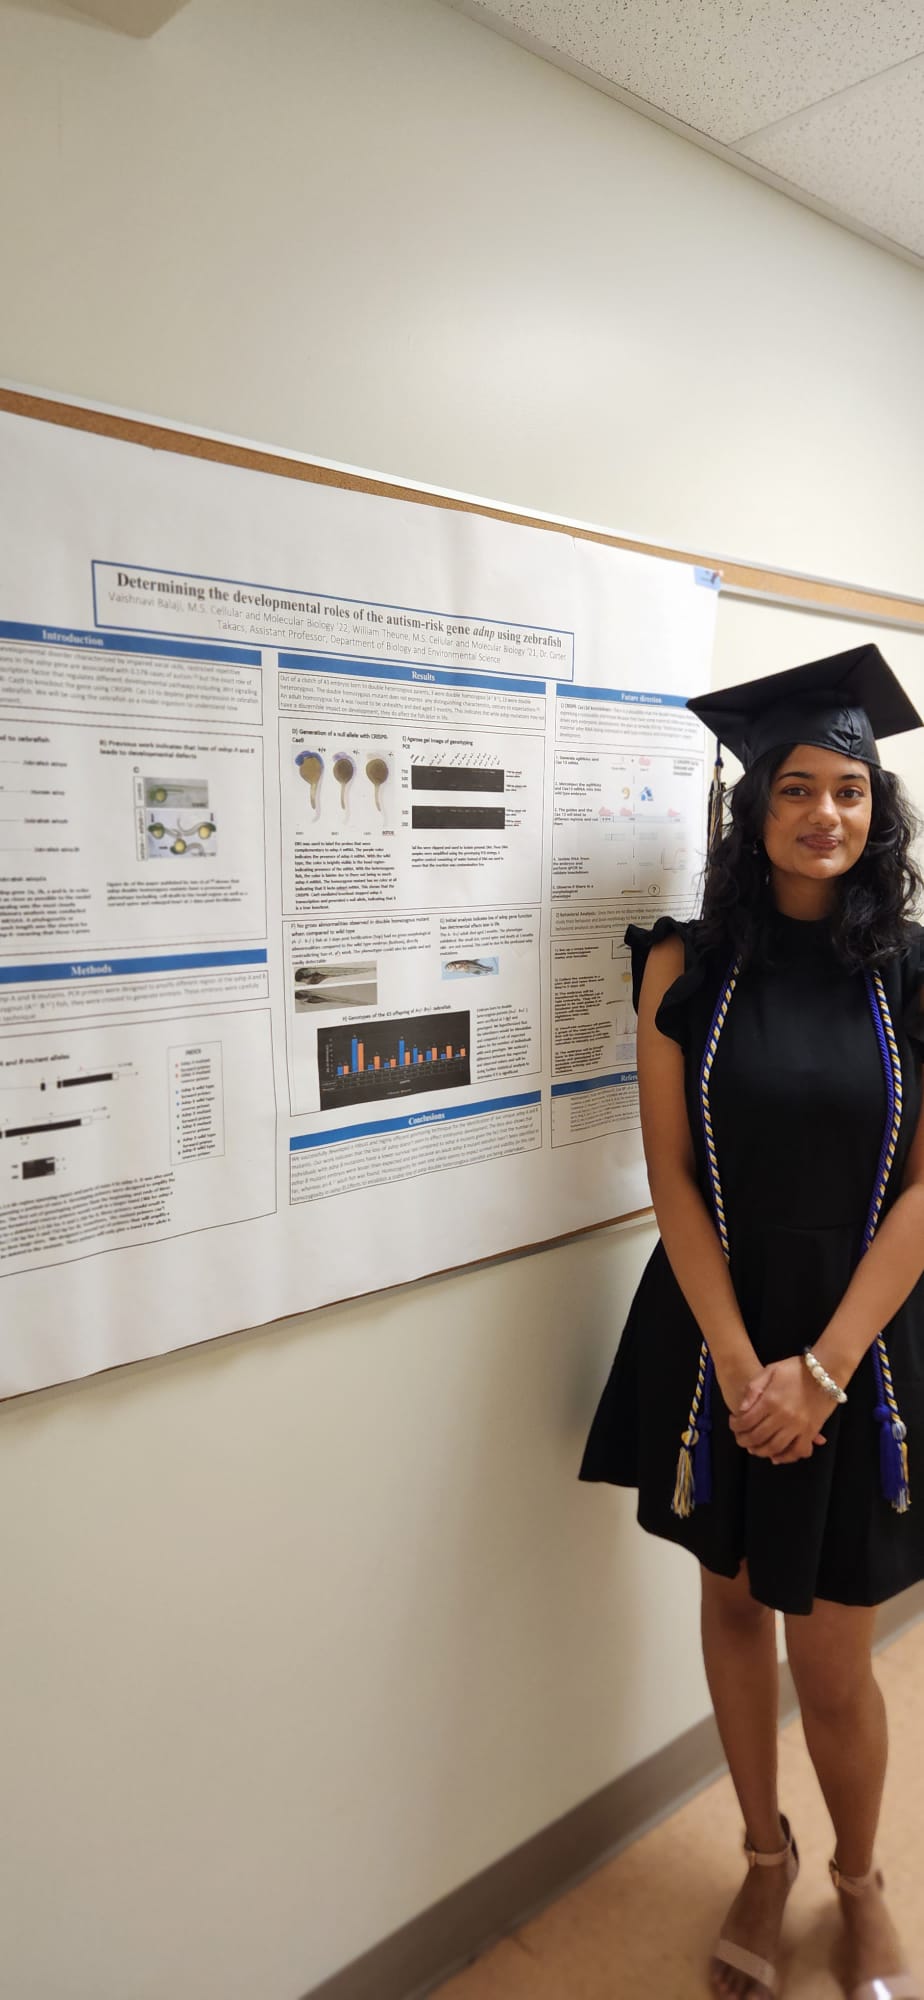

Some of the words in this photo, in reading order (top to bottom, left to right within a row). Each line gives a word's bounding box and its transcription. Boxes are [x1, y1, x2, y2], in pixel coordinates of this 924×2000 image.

[117, 572, 206, 600] Determining
[209, 586, 230, 601] the
[233, 590, 321, 614] developmental
[323, 604, 350, 618] roles
[353, 608, 365, 620] of
[366, 610, 384, 624] the
[386, 614, 444, 632] autism-risk
[446, 624, 471, 636] gene
[473, 624, 495, 641] adnp
[497, 630, 521, 645] using
[523, 630, 562, 648] zebrafish
[108, 591, 154, 607] Vaishnavi
[187, 603, 209, 614] M.S.
[210, 605, 243, 618] Cellular
[245, 610, 261, 621] and
[263, 613, 304, 626] Molecular
[307, 618, 335, 632] Biology
[353, 624, 380, 637] William
[382, 628, 411, 642] Theune,
[413, 632, 427, 642] M.S.
[429, 635, 454, 646] Cellular
[456, 638, 470, 648] and
[472, 640, 502, 652] Molecular
[504, 643, 526, 656] Biology
[539, 649, 548, 658] Dr.
[549, 650, 567, 661] Carter
[42, 629, 104, 647] Introduction
[217, 620, 247, 633] Takacs,
[250, 625, 286, 638] Assistant
[288, 629, 328, 644] Professor,
[330, 634, 375, 650] Department
[377, 640, 386, 650] of
[386, 641, 412, 655] Biology
[413, 645, 426, 654] and
[428, 647, 477, 660] Environmental
[479, 652, 502, 664] Science
[411, 670, 436, 681] Results
[621, 693, 639, 702] Future
[70, 963, 112, 977] Methods
[408, 1112, 446, 1126] Conclusions
